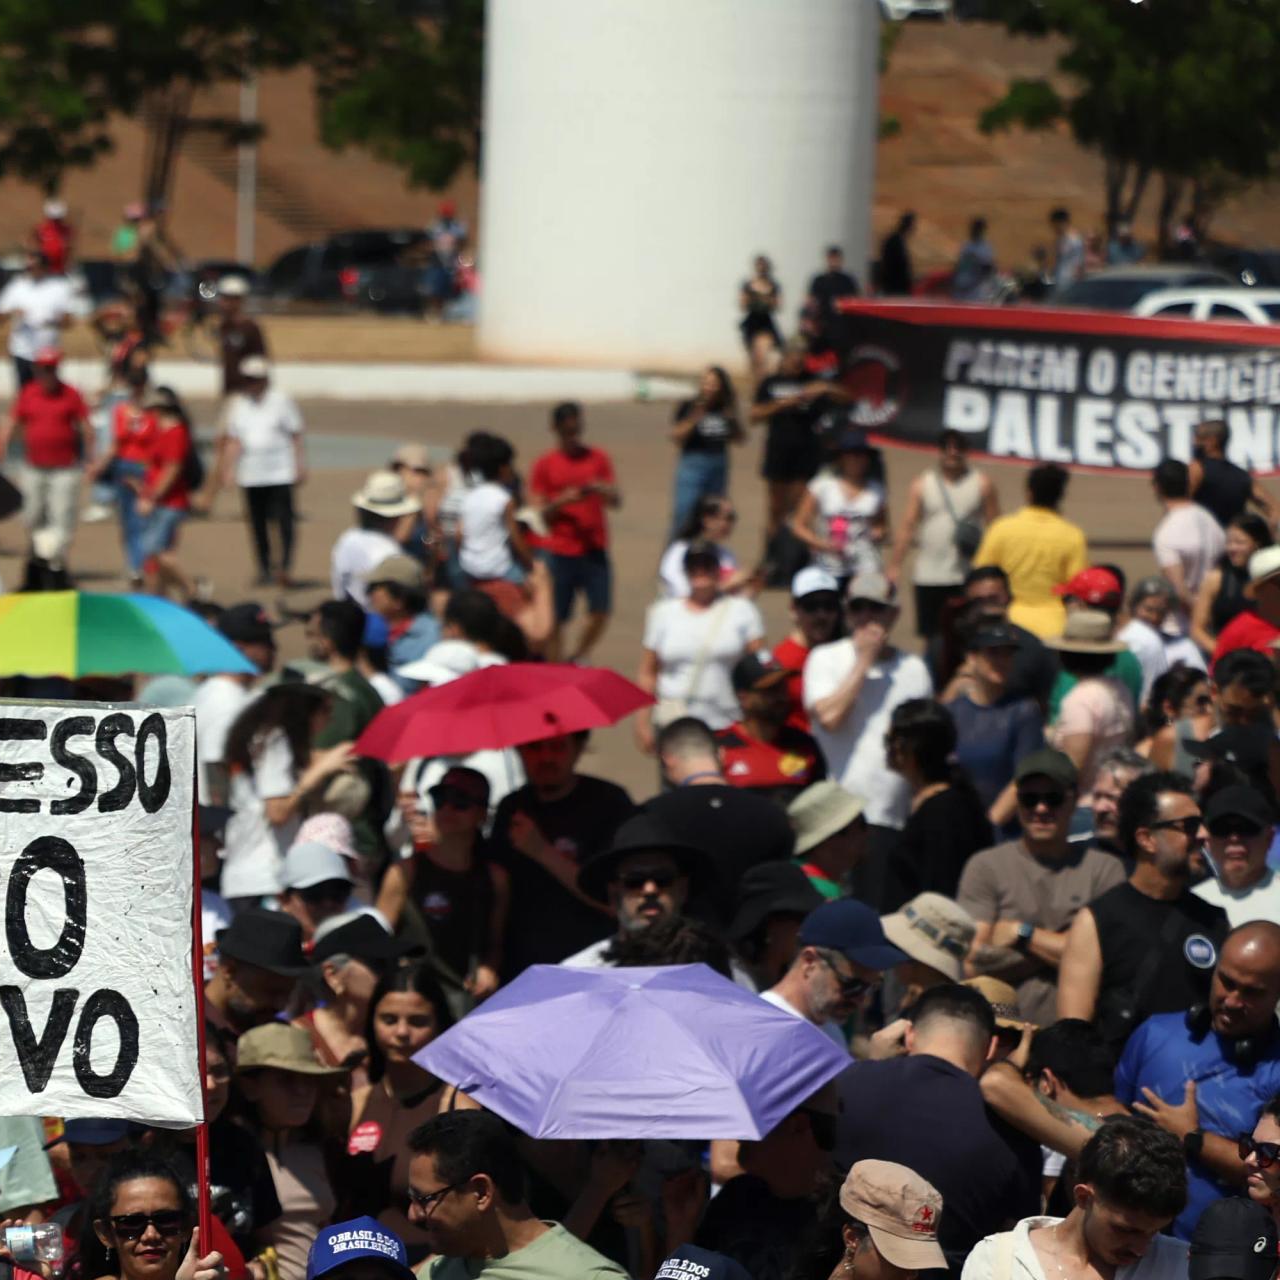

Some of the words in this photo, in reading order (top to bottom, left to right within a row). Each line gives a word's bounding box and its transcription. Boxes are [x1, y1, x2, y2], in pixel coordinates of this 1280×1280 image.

[945, 340, 1079, 393] PAREM
[1086, 348, 1118, 396] O
[943, 385, 1280, 475] PALESTN
[328, 1235, 336, 1246] O
[336, 1229, 373, 1244] BRASIL
[375, 1230, 385, 1244] É
[679, 1258, 690, 1271] É
[687, 1262, 711, 1279] DOS
